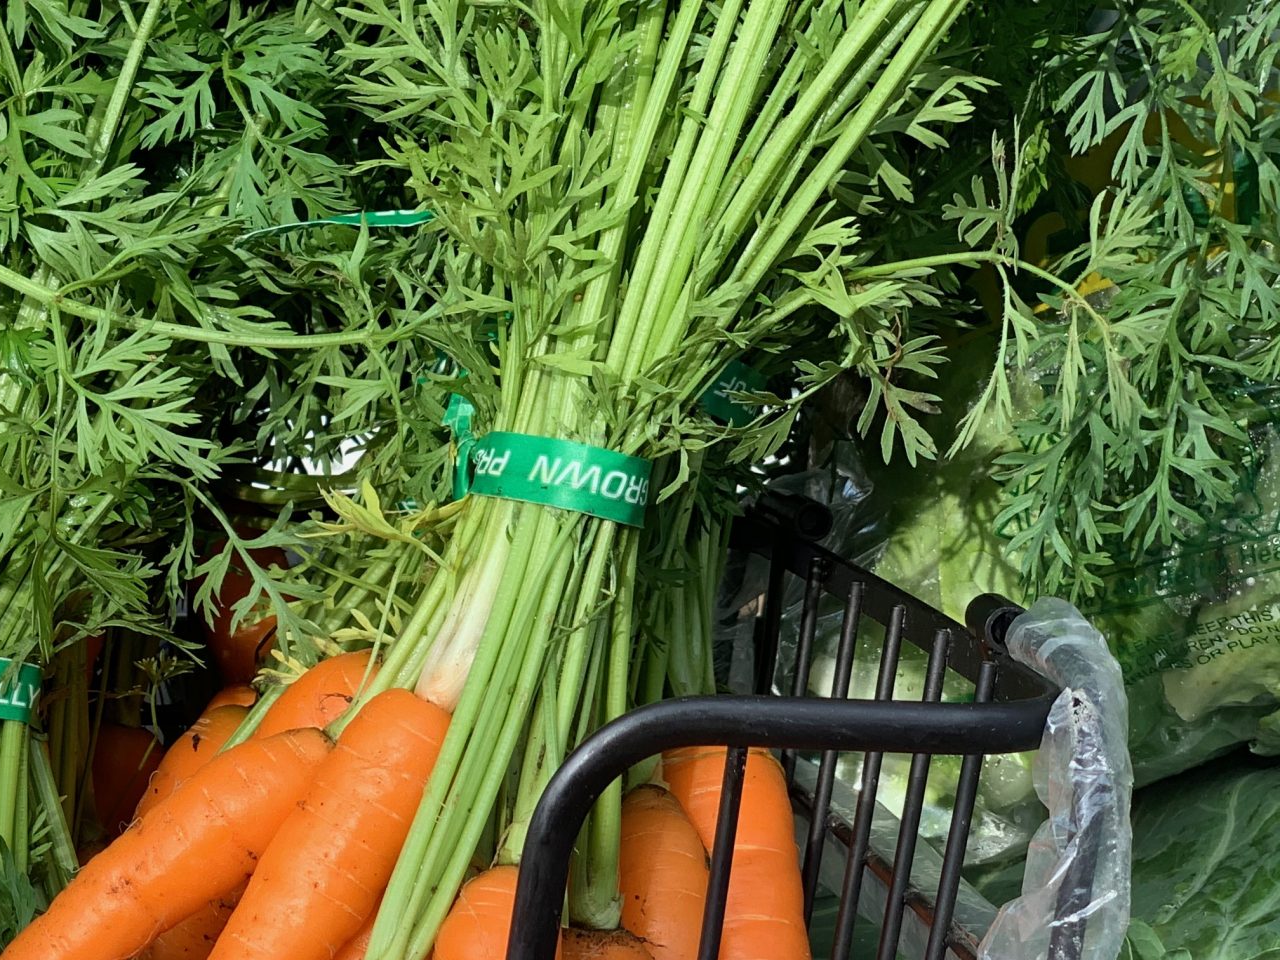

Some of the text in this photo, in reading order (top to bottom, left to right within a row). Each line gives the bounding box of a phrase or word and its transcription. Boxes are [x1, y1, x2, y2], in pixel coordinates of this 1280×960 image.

[527, 455, 649, 506] GROWN
[1192, 616, 1228, 635] EEP
[1197, 648, 1225, 665] OR
[1227, 635, 1270, 653] PLAY
